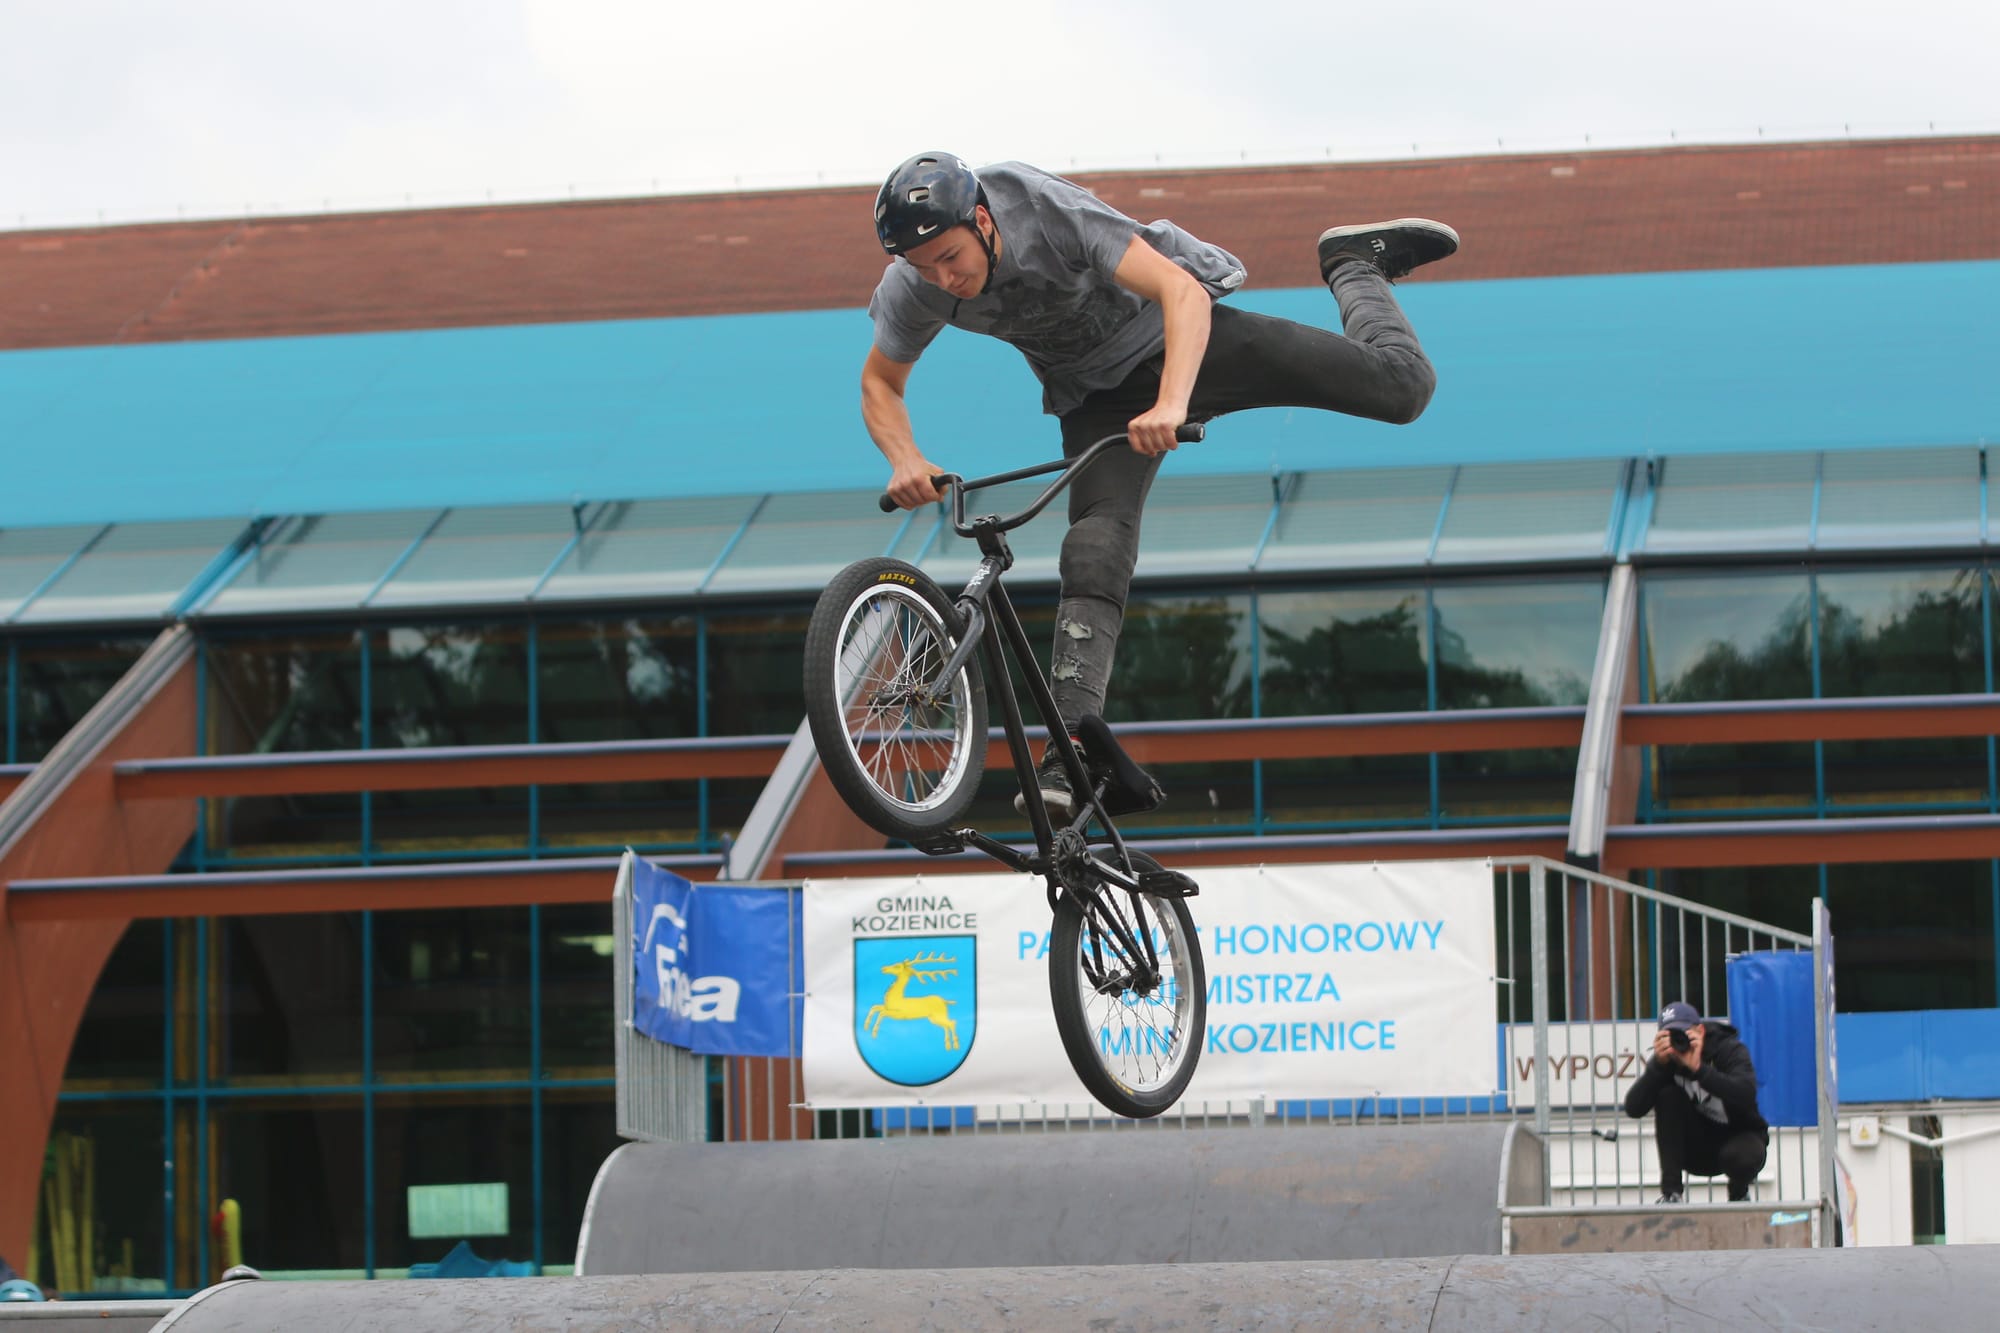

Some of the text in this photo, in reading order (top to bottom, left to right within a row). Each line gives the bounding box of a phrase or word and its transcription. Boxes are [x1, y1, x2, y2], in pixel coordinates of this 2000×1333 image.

[878, 572, 916, 585] MAXXIS
[876, 896, 953, 914] GMINA
[852, 913, 977, 932] KOZIENICE
[1214, 920, 1444, 955] HONOROWY
[1207, 1020, 1396, 1054] KOZIENICE
